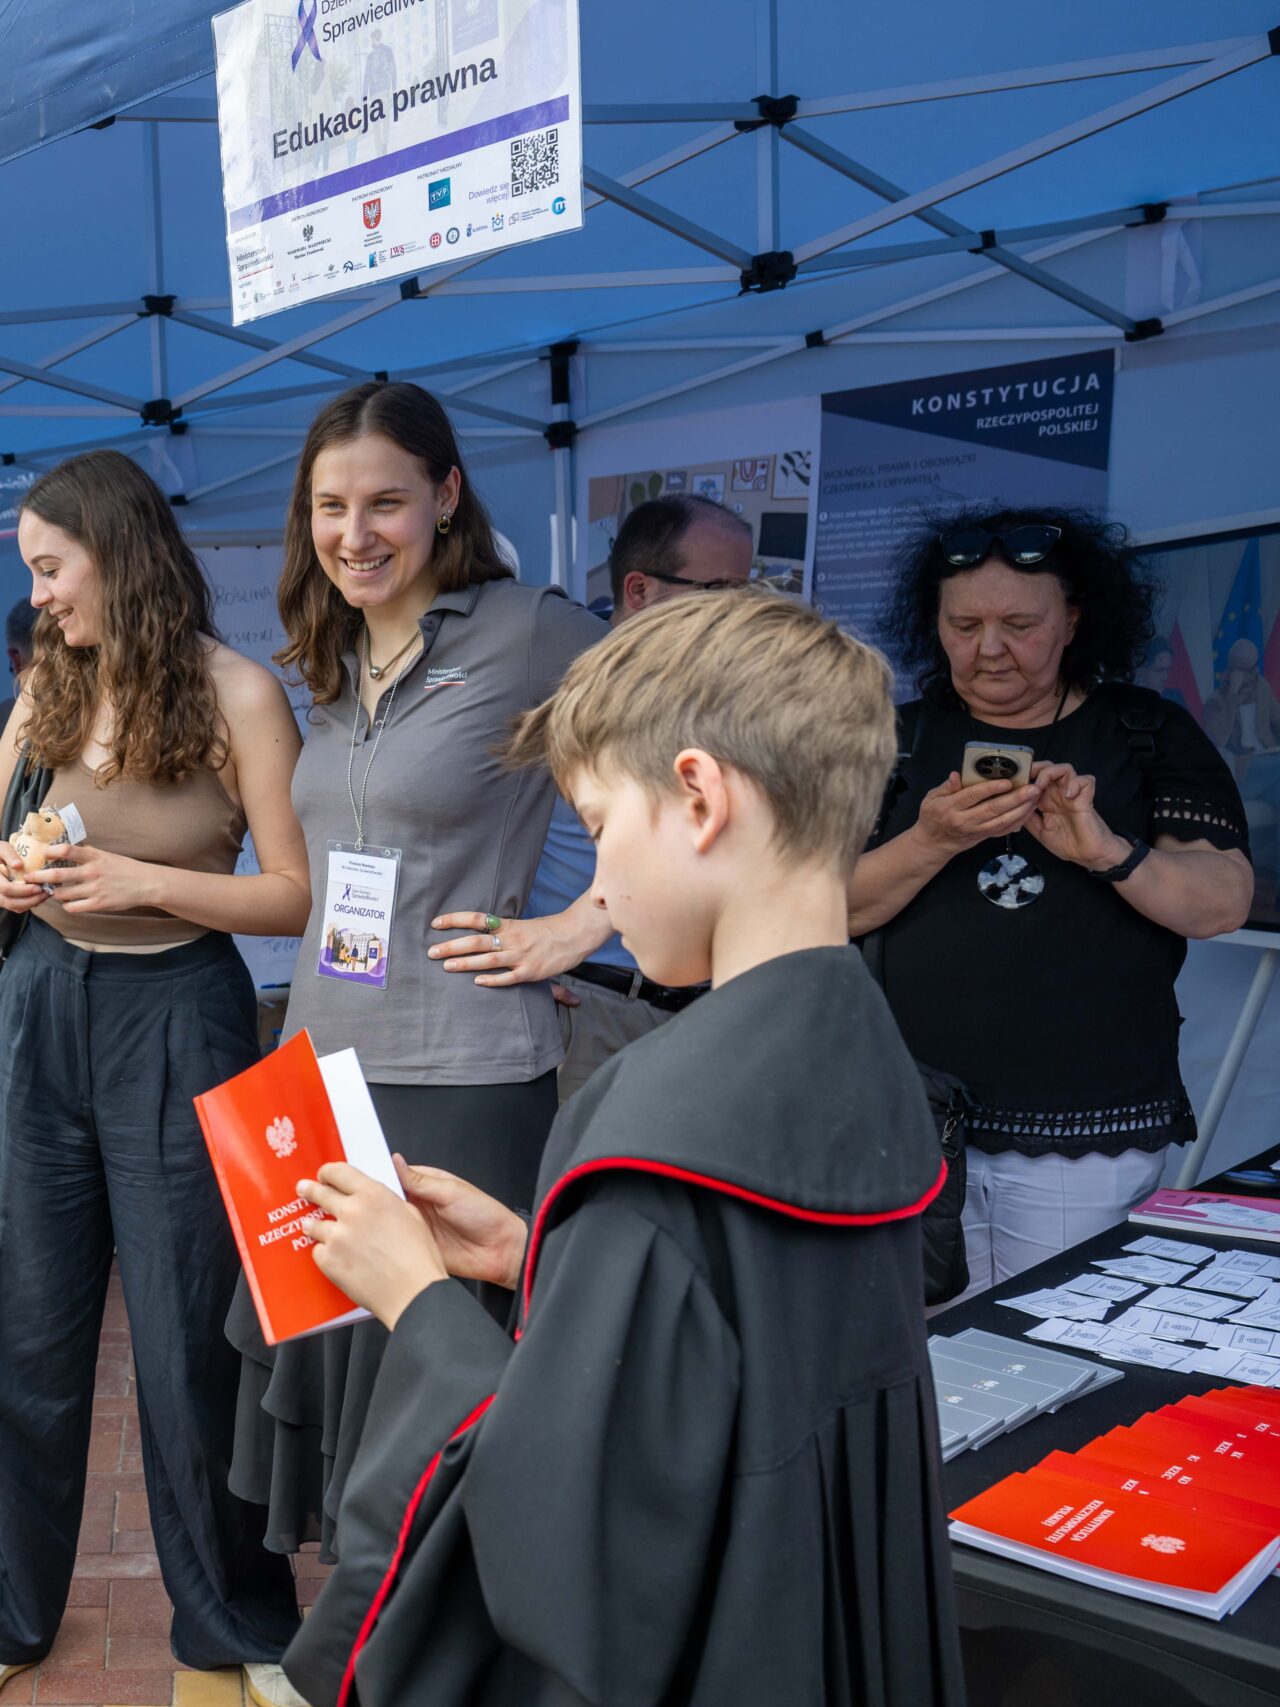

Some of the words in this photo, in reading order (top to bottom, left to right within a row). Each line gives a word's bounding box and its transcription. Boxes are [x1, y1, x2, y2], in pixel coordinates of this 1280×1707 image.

[322, 0, 426, 43] Sprawiedliw
[272, 95, 386, 159] Edukacja
[392, 57, 498, 122] prawna
[431, 186, 448, 201] TVP
[468, 184, 498, 200] Dowiedz
[499, 182, 510, 193] się
[911, 372, 1101, 416] KONSTYTUCJA
[976, 402, 1099, 430] RZECZYPOSPOLITEJ
[1038, 419, 1098, 437] POLSKIEJ
[877, 460, 911, 474] PRAWA
[919, 453, 977, 469] OBOWIĄZKI
[16, 843, 30, 858] MS
[333, 903, 386, 921] ORGANIZATOR
